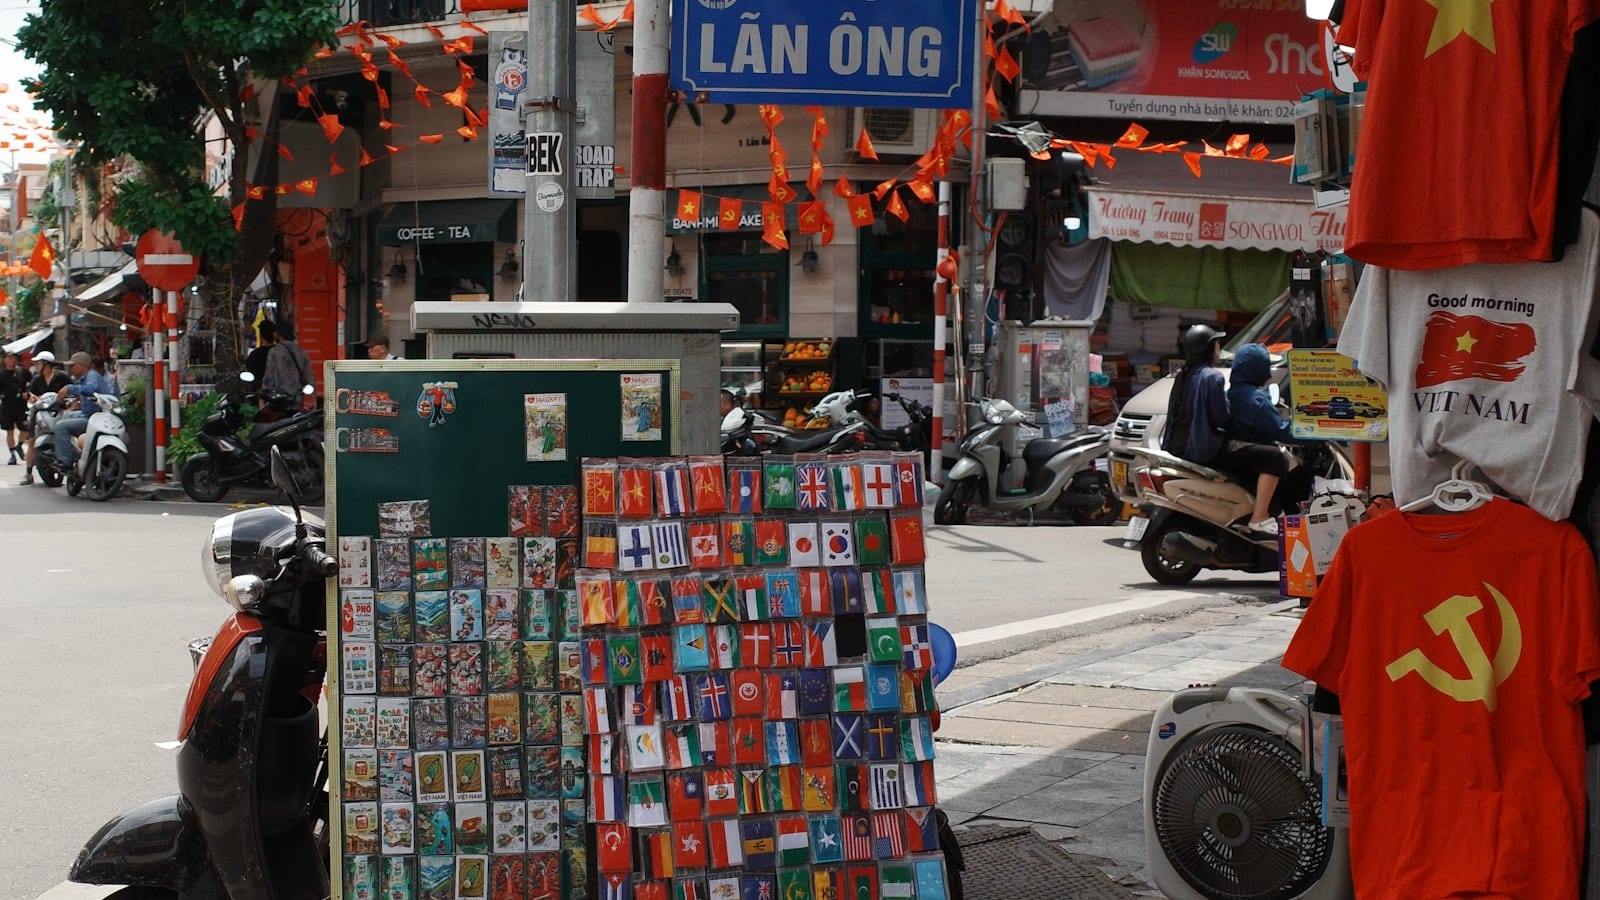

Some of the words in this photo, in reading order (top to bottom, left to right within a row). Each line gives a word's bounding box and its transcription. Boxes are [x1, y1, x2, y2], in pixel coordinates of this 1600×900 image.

[699, 11, 809, 75] LÃN
[828, 11, 942, 78] ÔNG
[1204, 69, 1251, 80] SONGWOL
[1109, 99, 1143, 114] Tuyển
[1147, 101, 1176, 116] dụng
[1180, 102, 1201, 115] nhà
[1204, 103, 1227, 115] bán
[1242, 104, 1274, 118] khăn:
[1098, 198, 1146, 225] Hương
[1152, 200, 1195, 229] Trang
[397, 227, 435, 240] COFFEE
[447, 226, 471, 239] TEA
[1229, 220, 1303, 242] SONGWOL
[1427, 293, 1468, 308] Good
[1471, 297, 1535, 317] morning
[1464, 394, 1531, 425] NAM
